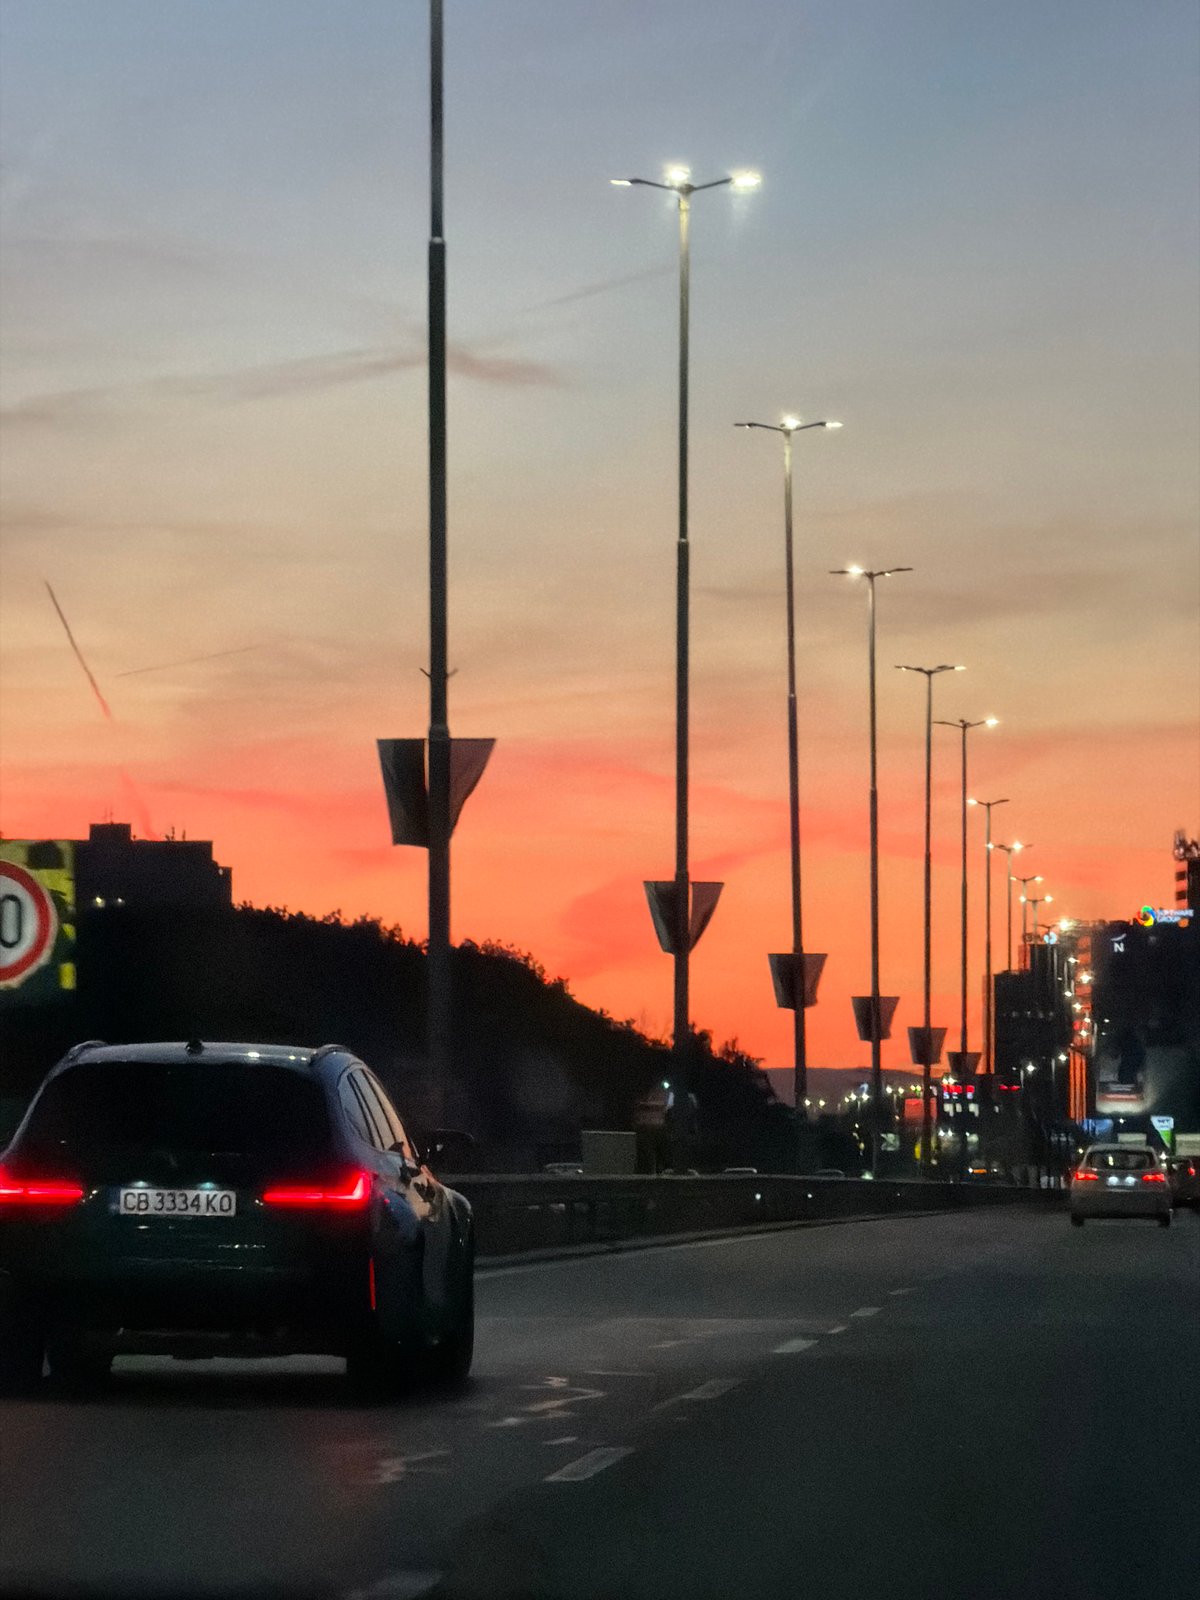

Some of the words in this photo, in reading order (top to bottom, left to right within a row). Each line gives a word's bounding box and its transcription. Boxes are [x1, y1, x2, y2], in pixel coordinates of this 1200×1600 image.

[1114, 942, 1124, 952] N
[123, 1192, 149, 1211] CB
[153, 1192, 201, 1213] 3334
